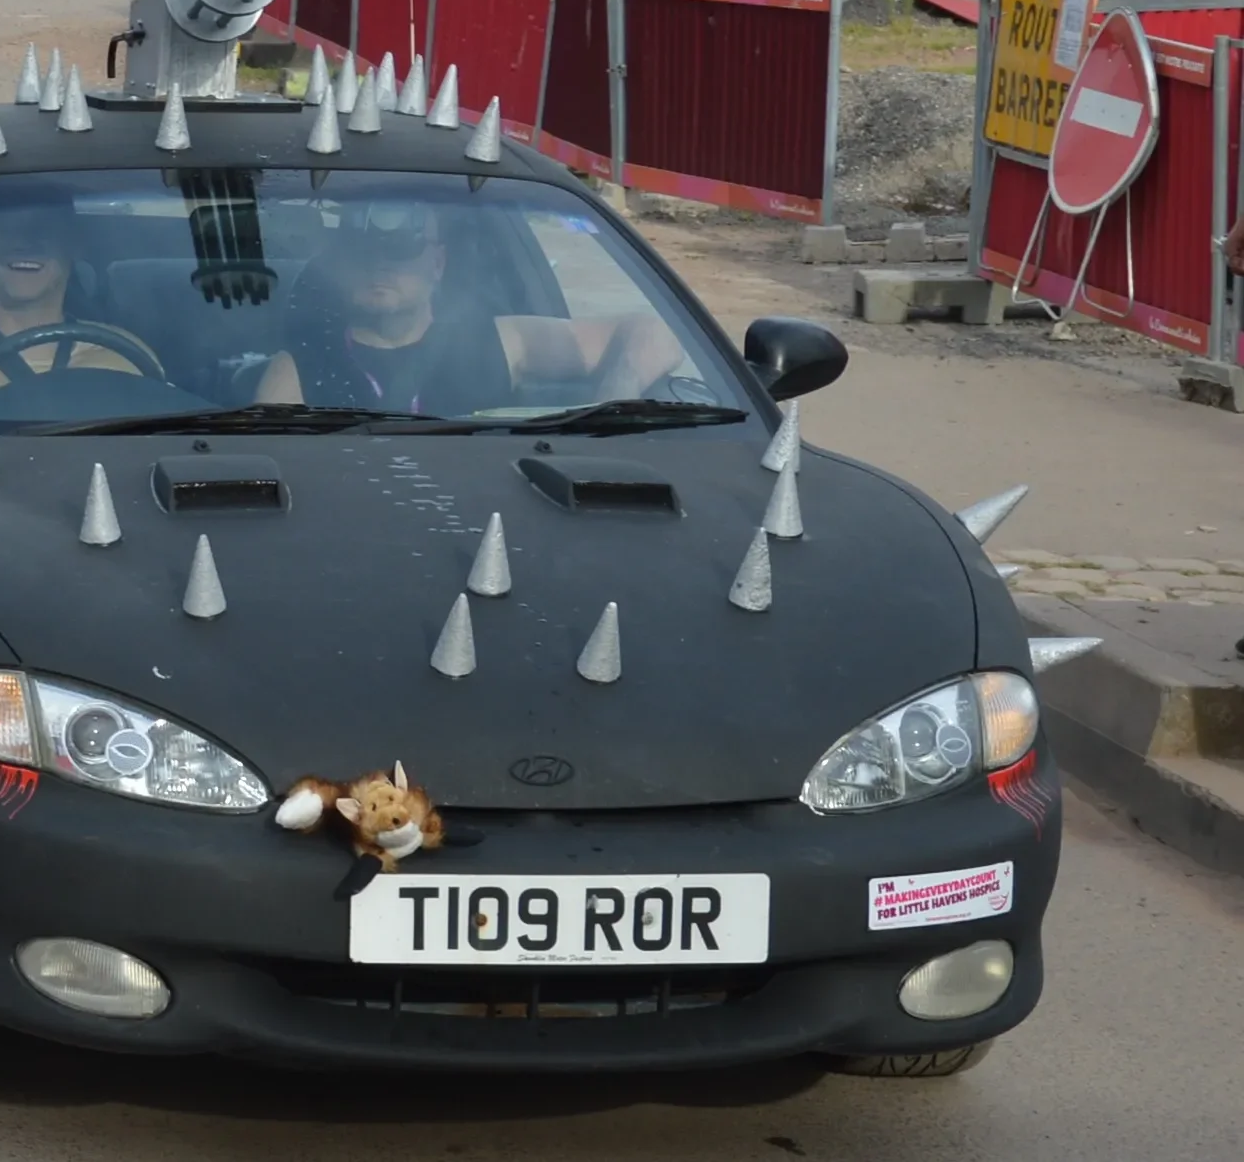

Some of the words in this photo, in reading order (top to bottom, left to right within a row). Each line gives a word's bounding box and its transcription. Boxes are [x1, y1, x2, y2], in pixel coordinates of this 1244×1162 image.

[877, 881, 895, 894] I'M
[877, 907, 897, 920] FOR
[899, 899, 929, 916] LITTLE
[932, 891, 967, 909] HAVENS
[969, 879, 1000, 900] HOSPICE
[583, 886, 723, 952] ROR
